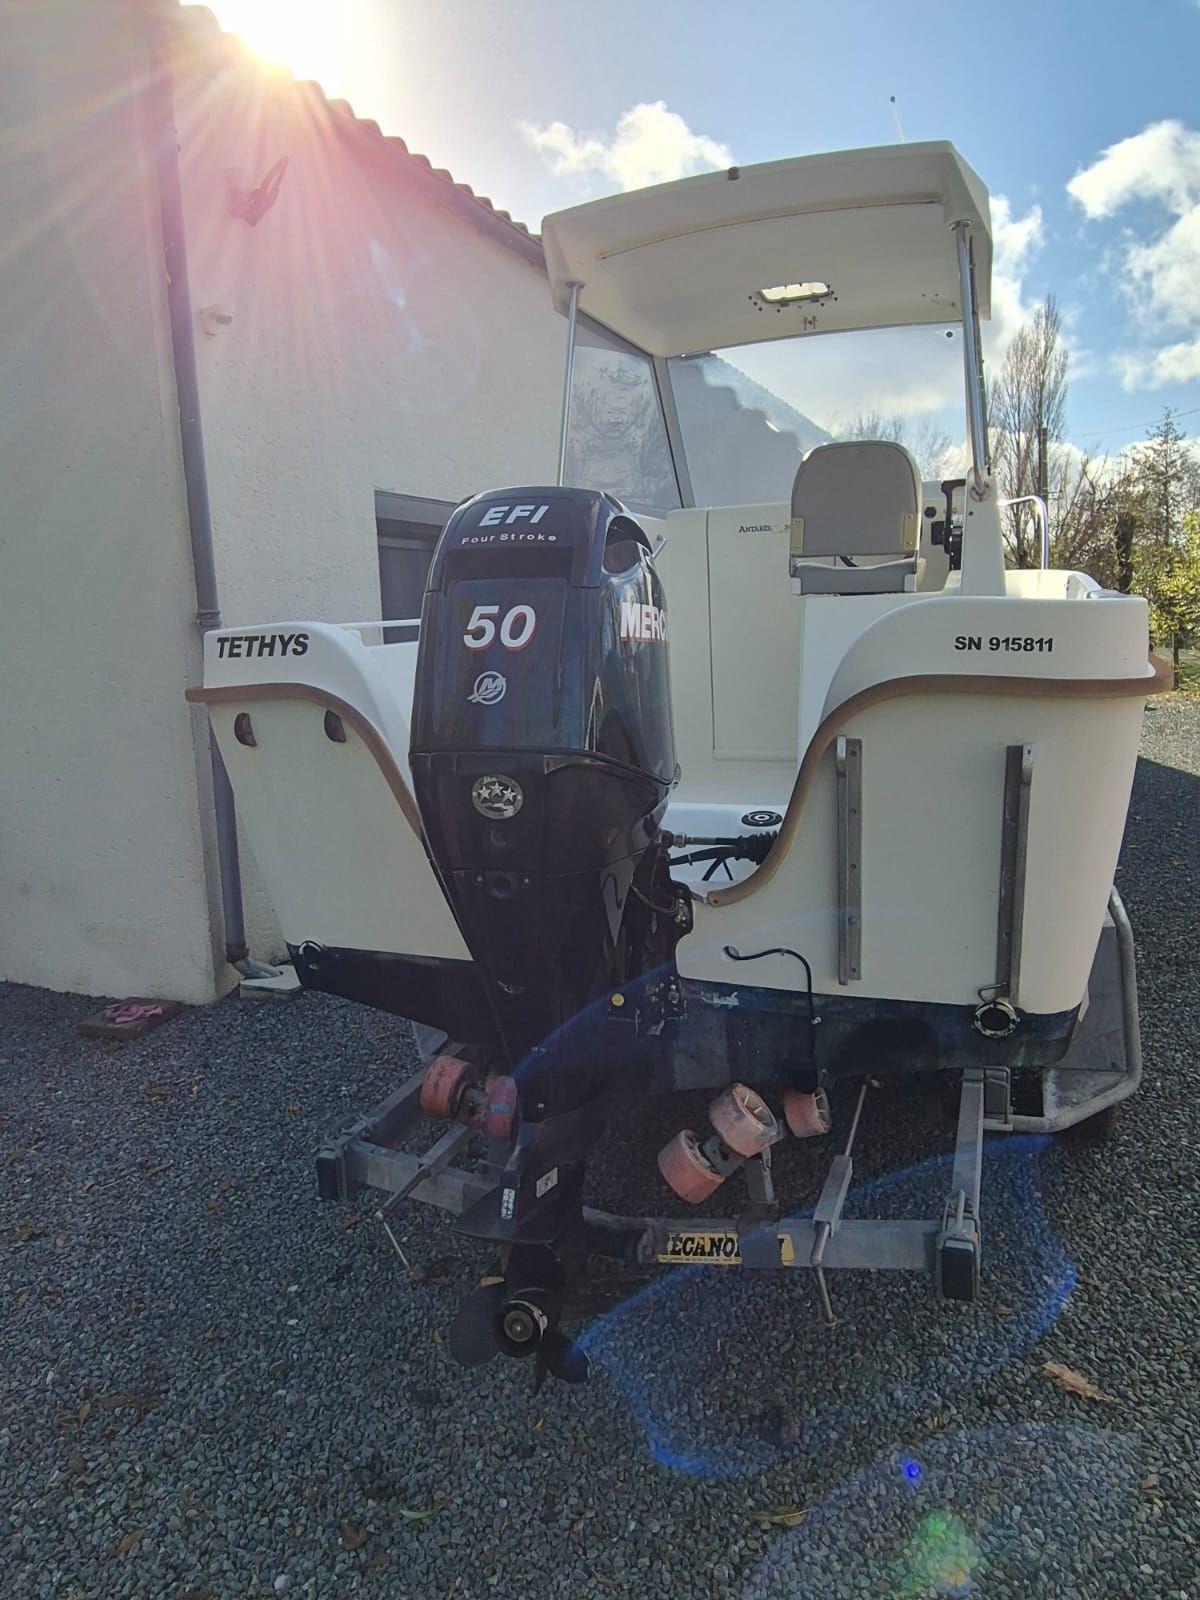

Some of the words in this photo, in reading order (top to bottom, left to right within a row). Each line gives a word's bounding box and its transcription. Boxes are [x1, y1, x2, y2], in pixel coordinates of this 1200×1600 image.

[479, 505, 549, 526] EFI
[461, 536, 496, 544] Four
[500, 533, 557, 541] Stroke
[463, 604, 537, 650] 50
[620, 602, 668, 642] MERC
[216, 633, 309, 658] TETHYS
[954, 636, 982, 650] SN
[988, 636, 1053, 652] 915811
